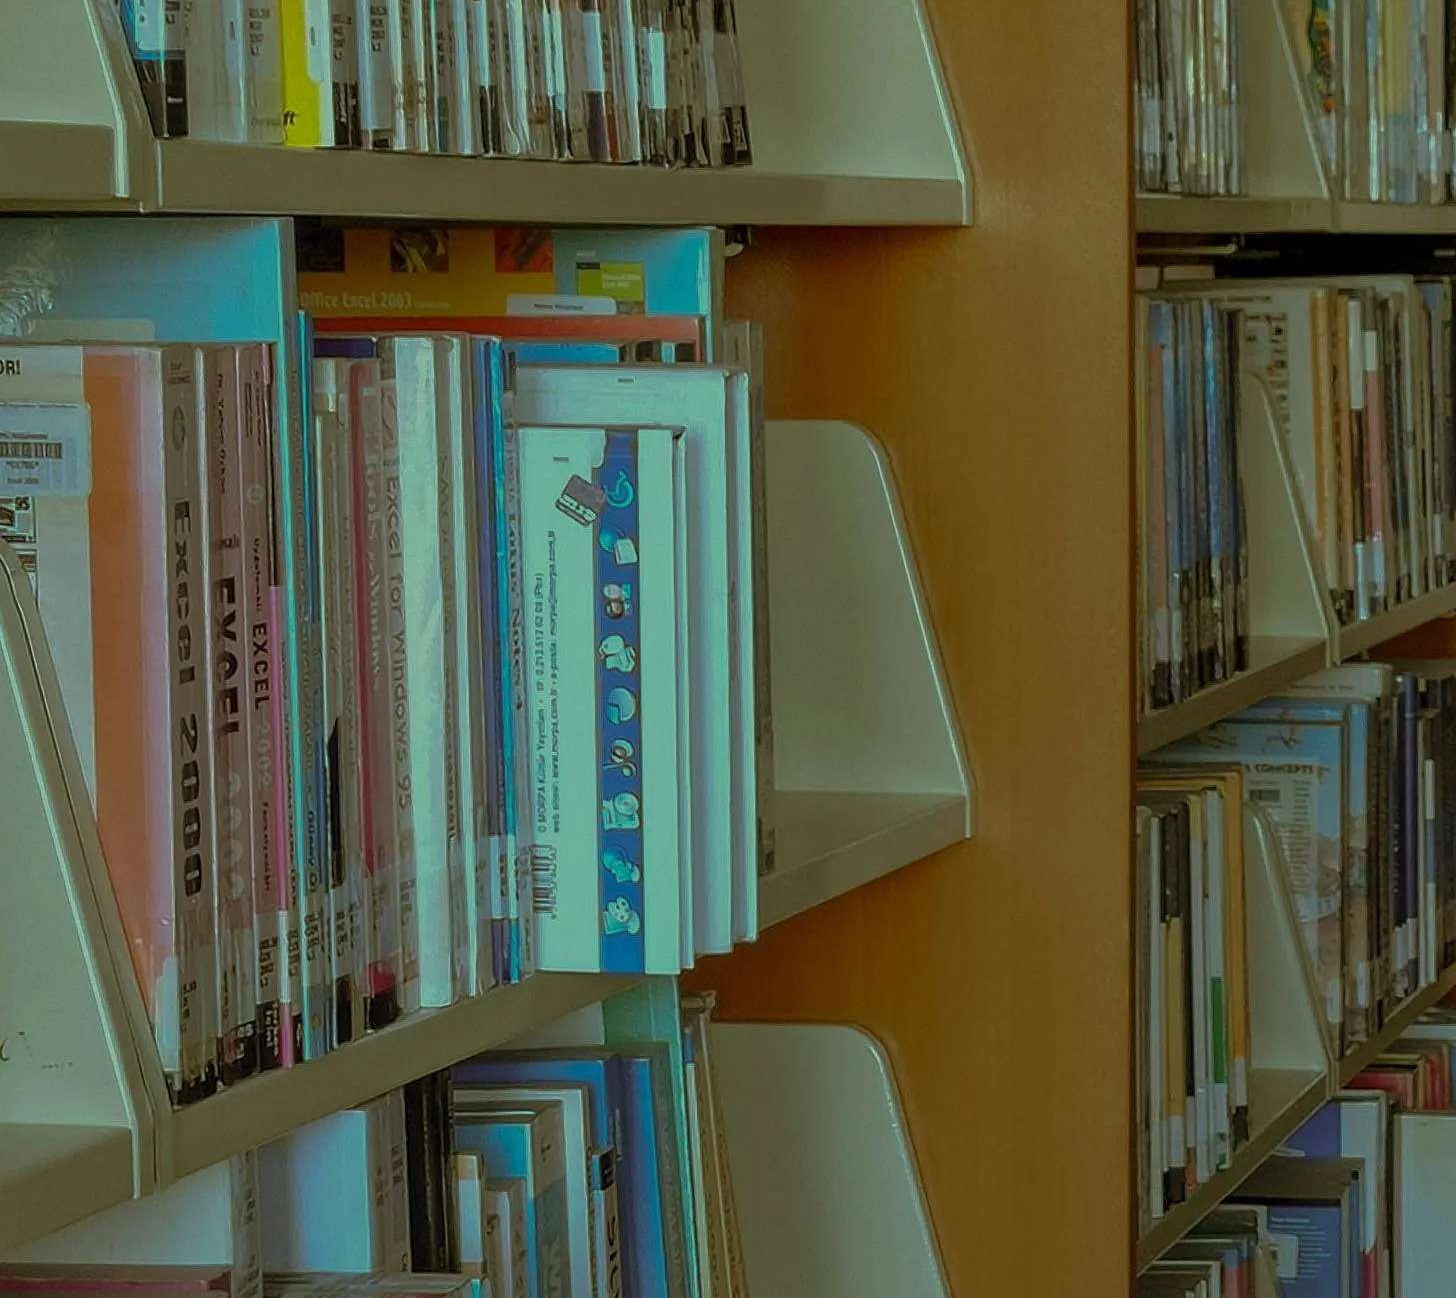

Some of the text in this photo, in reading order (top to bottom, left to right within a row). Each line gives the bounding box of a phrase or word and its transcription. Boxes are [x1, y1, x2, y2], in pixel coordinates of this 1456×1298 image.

[341, 291, 377, 309] Excel
[379, 291, 412, 310] 2003
[172, 500, 203, 898] Excel 2000
[213, 576, 241, 741] EXCEL
[251, 620, 270, 712] EXCEL
[386, 474, 413, 811] Excel for Windows 95
[511, 607, 524, 687] Notes
